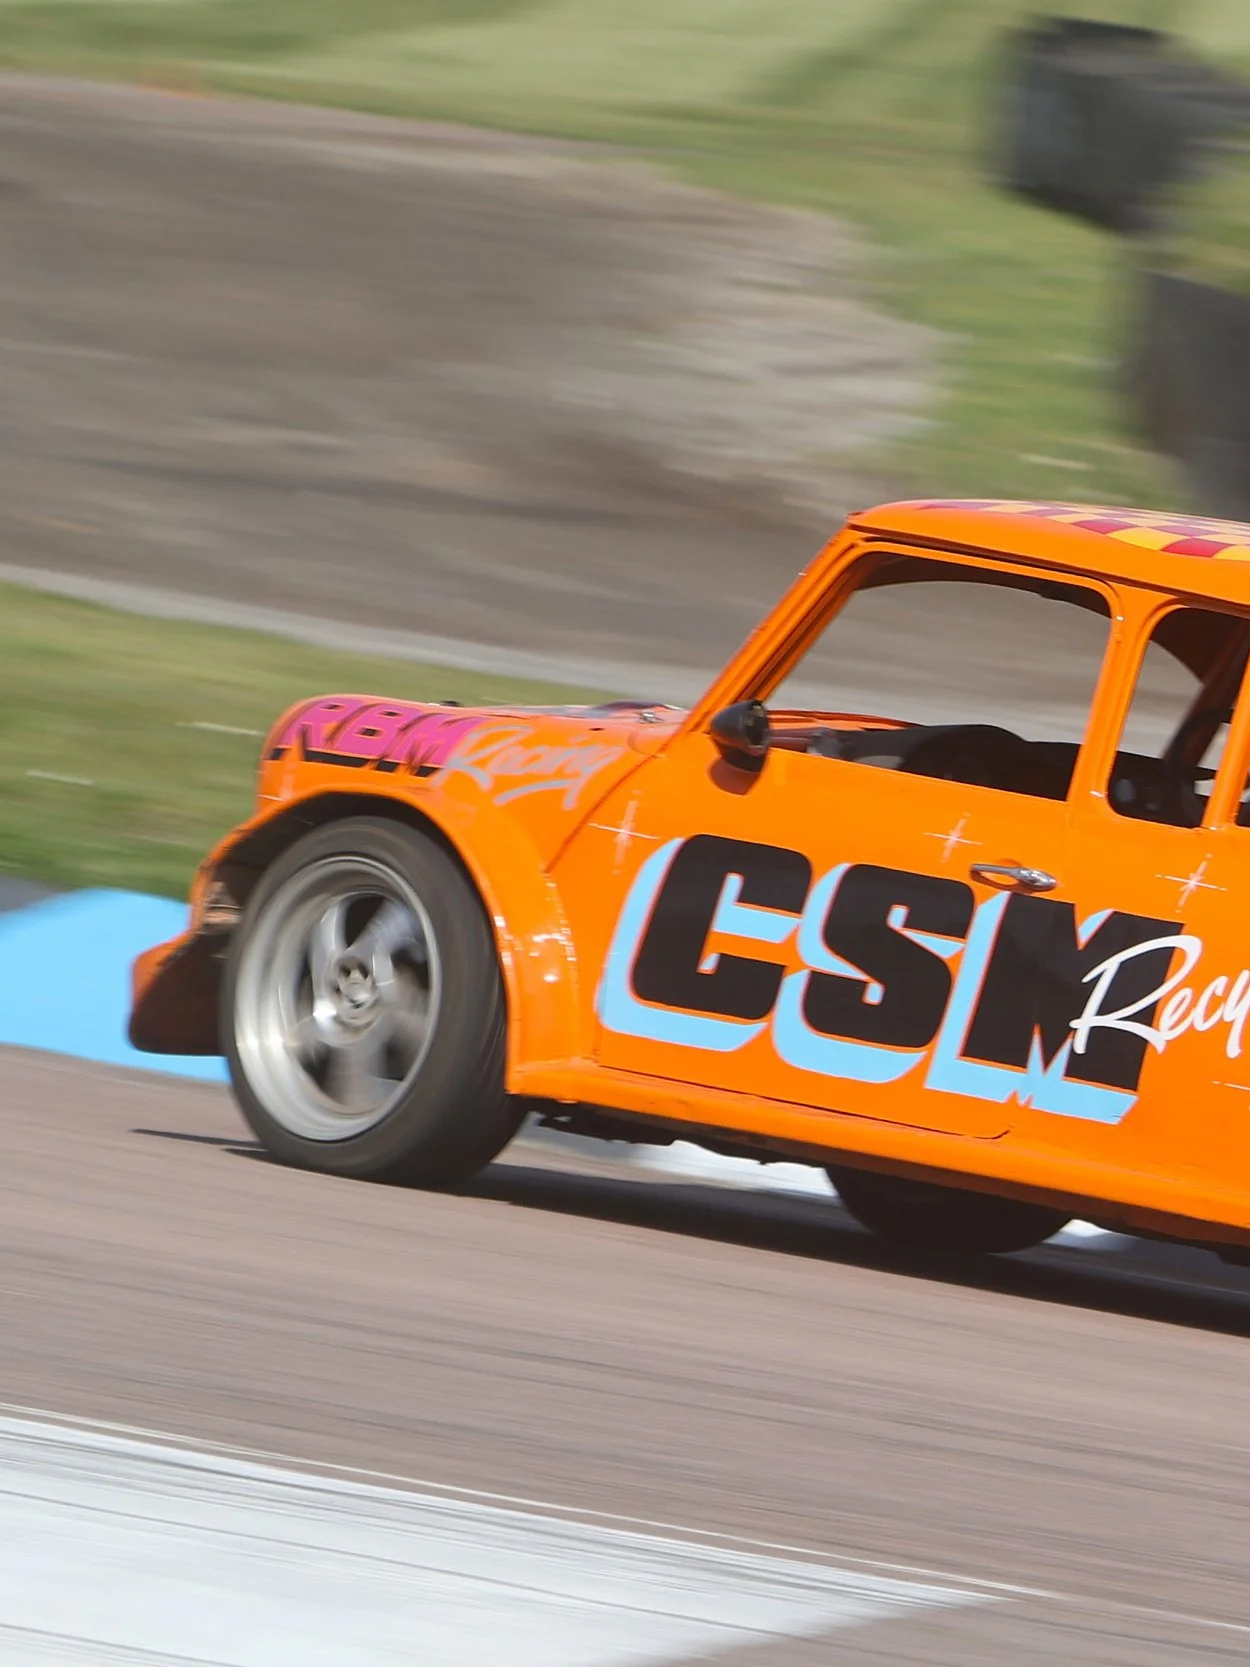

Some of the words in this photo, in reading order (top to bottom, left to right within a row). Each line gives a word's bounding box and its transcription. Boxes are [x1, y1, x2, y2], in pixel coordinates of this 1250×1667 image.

[265, 696, 486, 777] RBM
[438, 724, 626, 810] Racing
[594, 834, 1184, 1125] CSM
